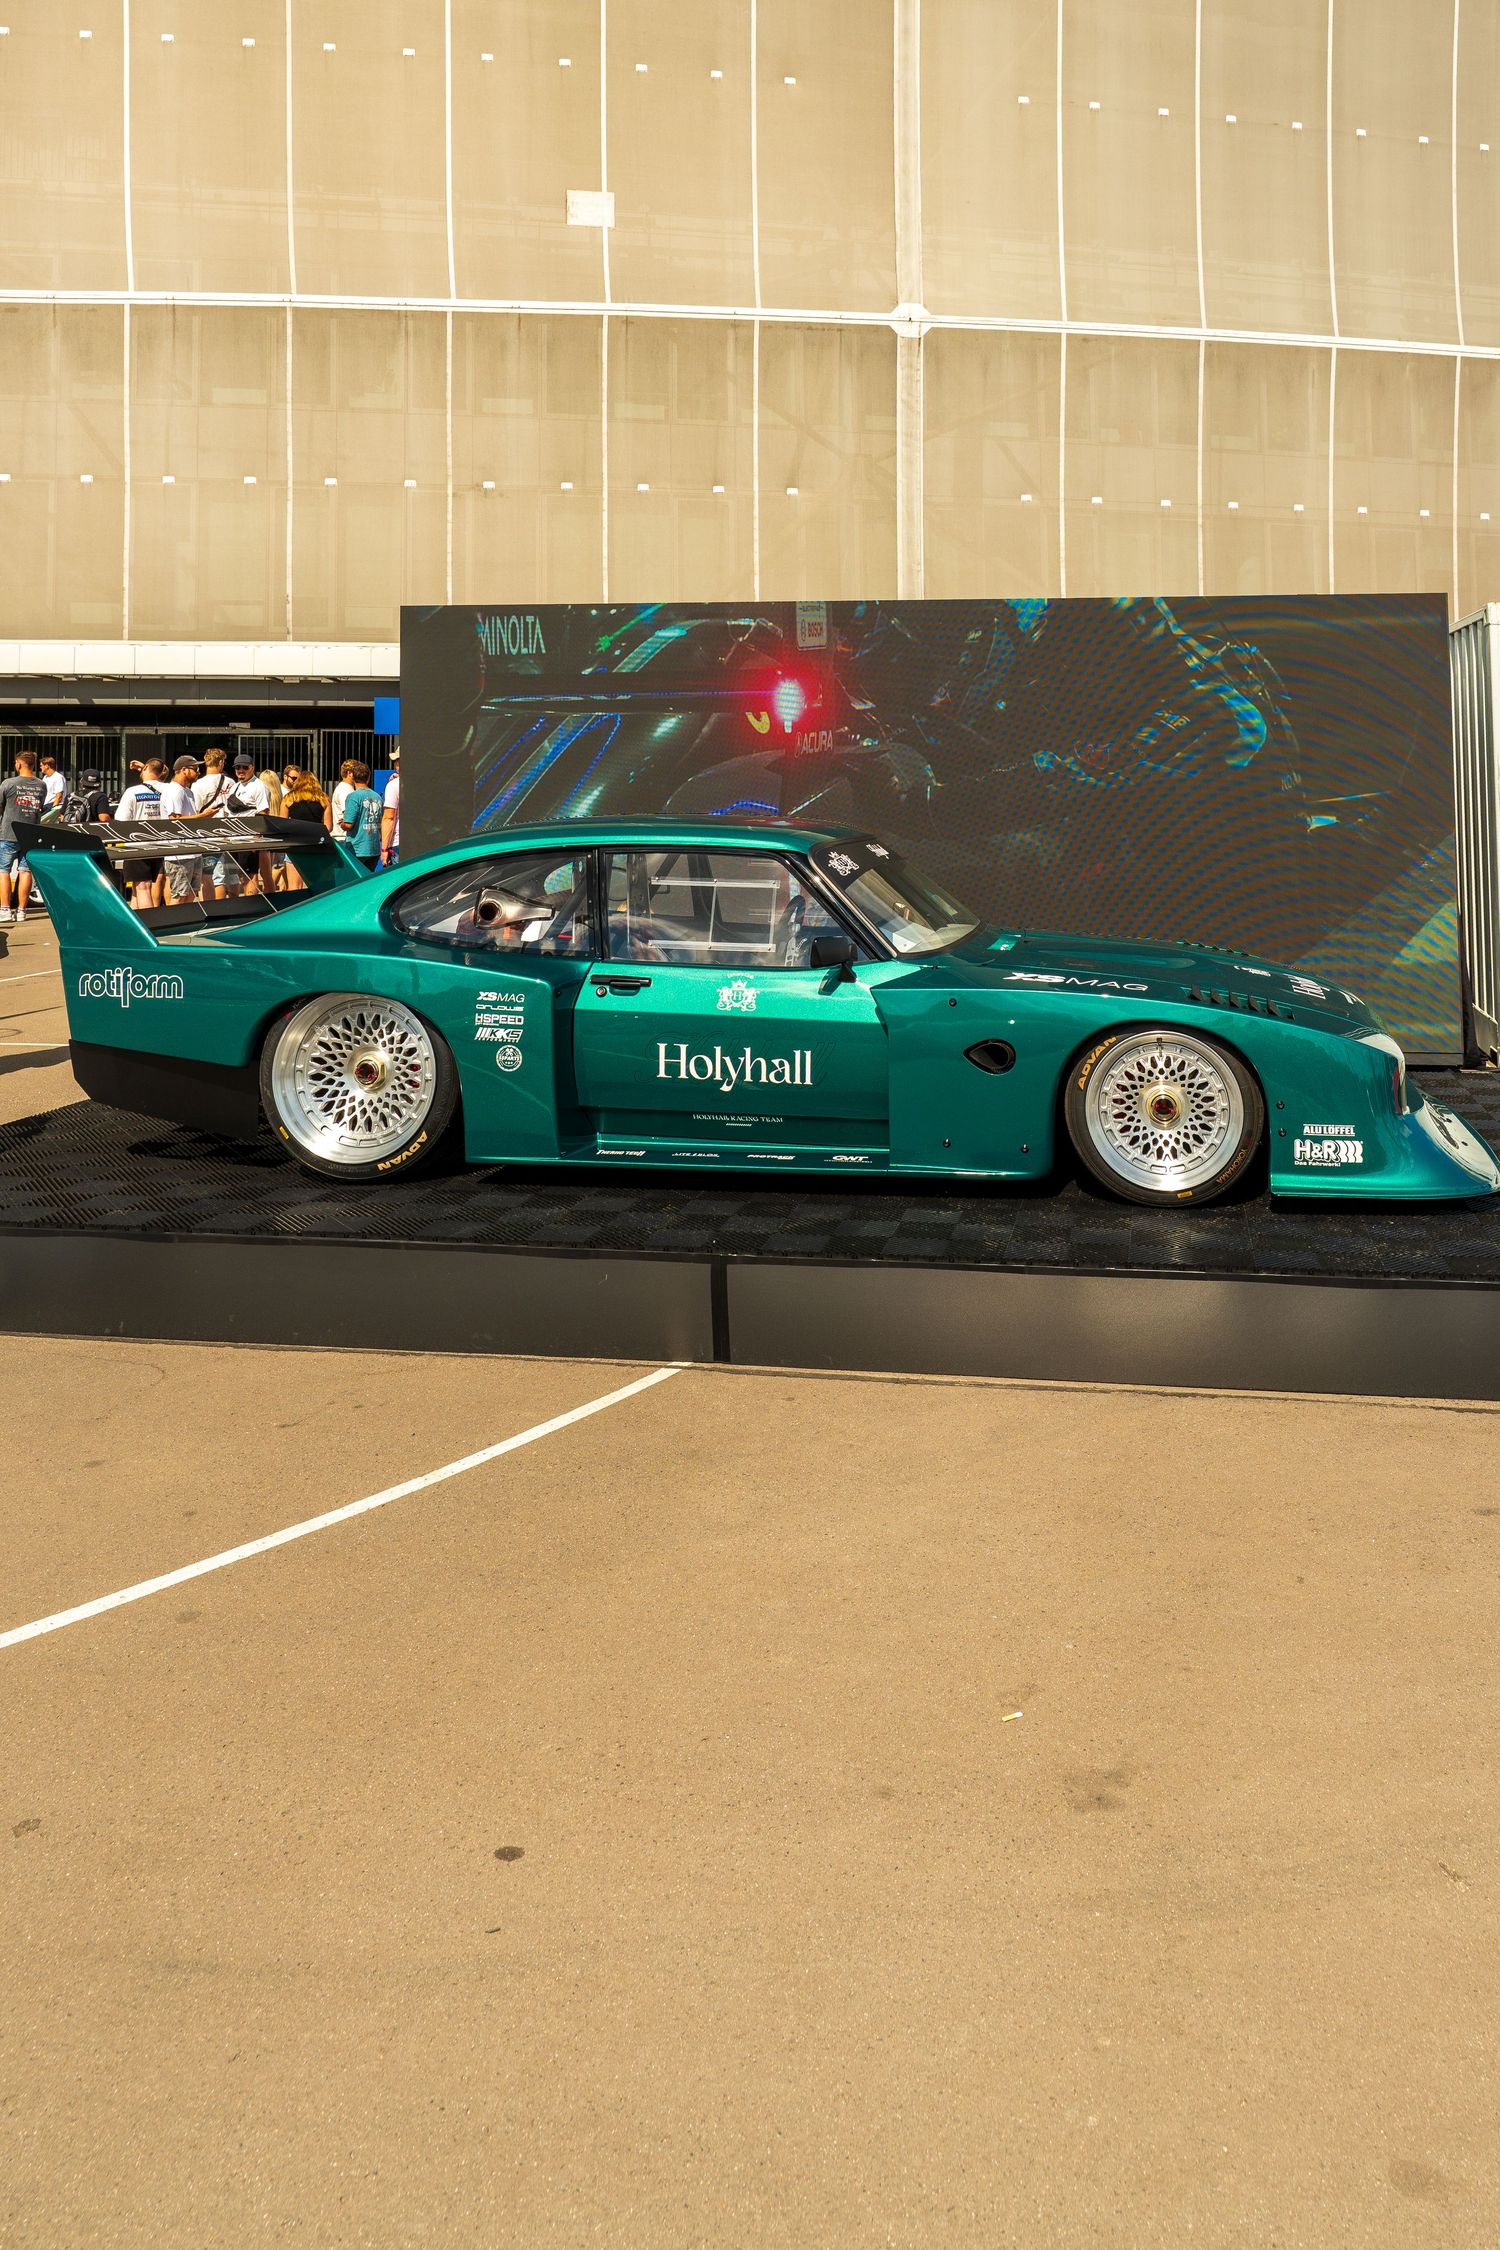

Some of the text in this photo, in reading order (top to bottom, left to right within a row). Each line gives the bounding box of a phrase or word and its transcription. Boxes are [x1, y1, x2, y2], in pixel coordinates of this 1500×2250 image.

[481, 615, 546, 656] MINOLTA
[801, 729, 834, 755] ACURA
[79, 966, 184, 1008] rotiform
[656, 1042, 813, 1092] Holyhall
[1077, 1035, 1118, 1091] ADVAN
[377, 1130, 428, 1171] ADVAN
[1216, 1149, 1248, 1184] YOKOHAMA
[1294, 1138, 1340, 1163] H&R
